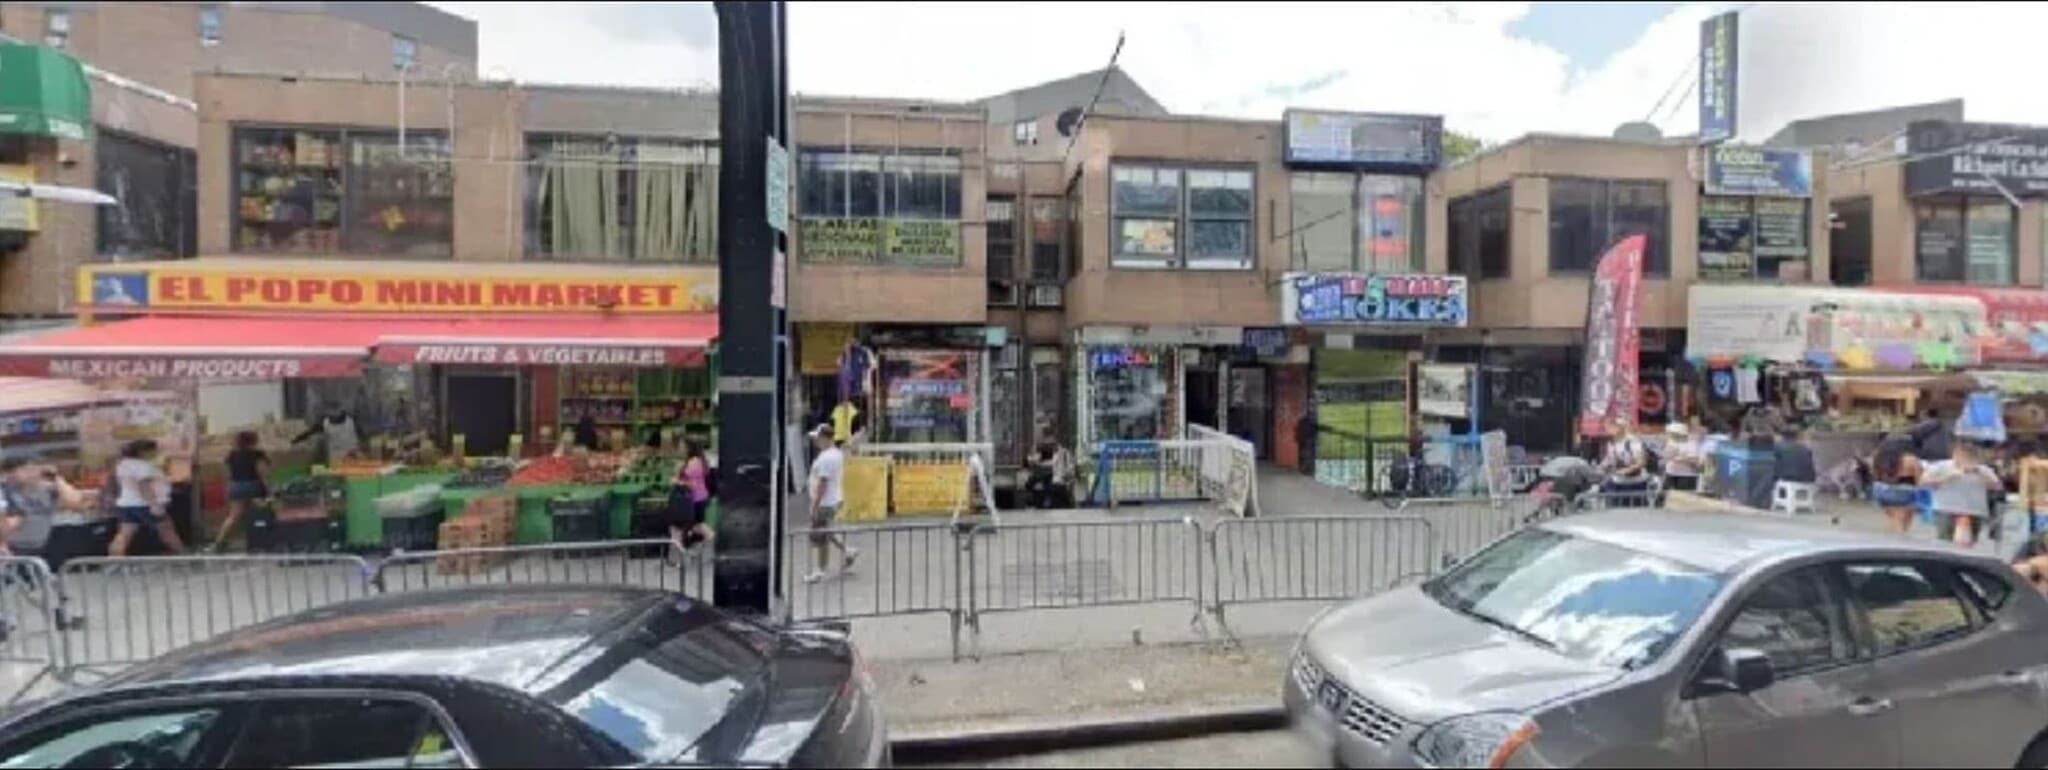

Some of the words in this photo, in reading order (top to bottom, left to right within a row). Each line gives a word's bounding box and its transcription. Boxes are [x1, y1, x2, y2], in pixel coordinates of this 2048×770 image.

[158, 277, 214, 301] EL
[226, 277, 363, 304] POPO
[376, 281, 482, 306] MINI
[491, 284, 678, 306] MARKET
[502, 347, 519, 363] &
[526, 348, 666, 364] VEGETABLES
[49, 359, 165, 377] MEXICAN
[171, 360, 301, 377] PRODUCTS
